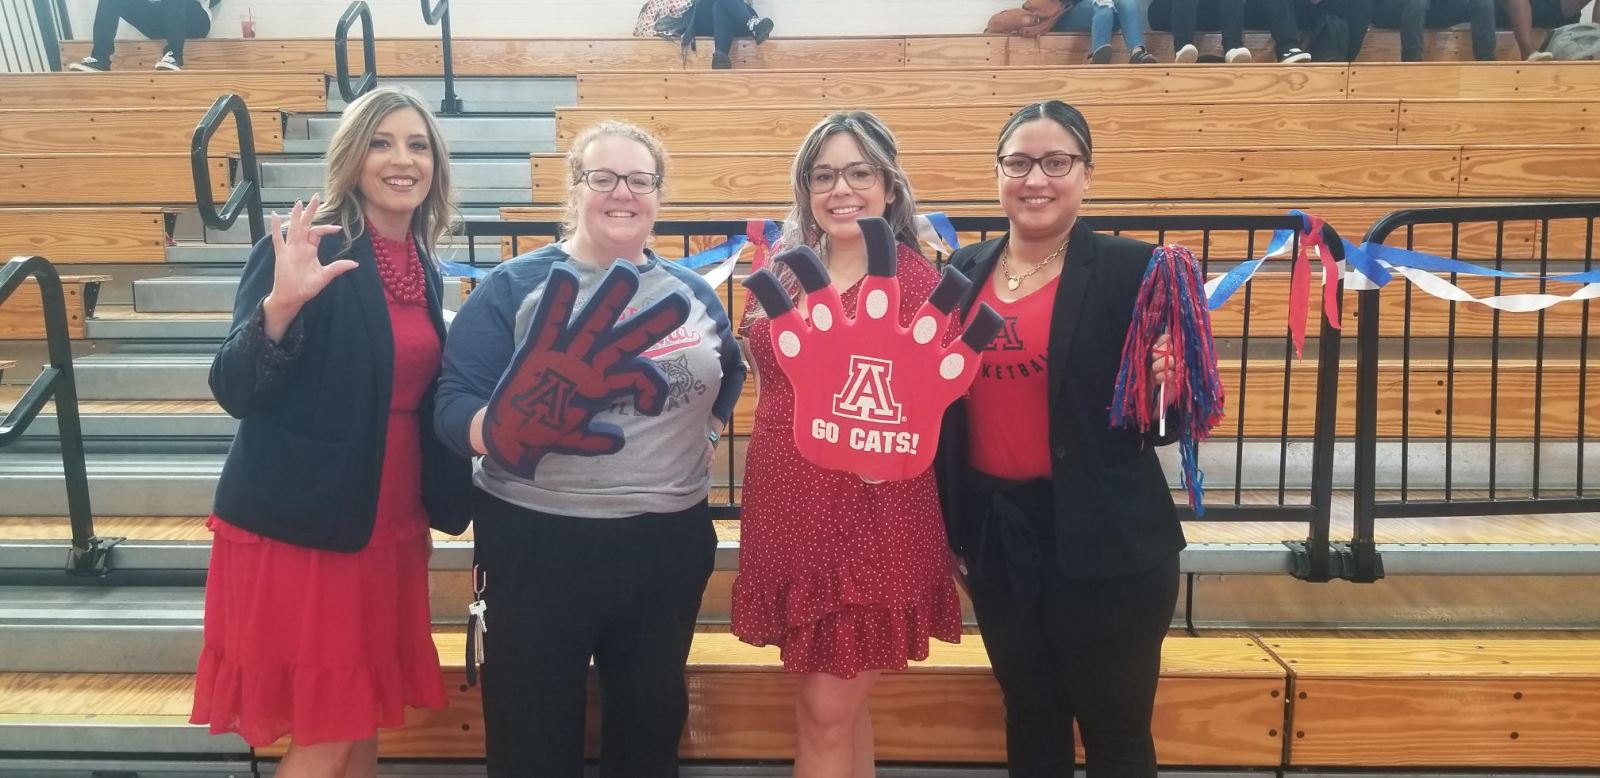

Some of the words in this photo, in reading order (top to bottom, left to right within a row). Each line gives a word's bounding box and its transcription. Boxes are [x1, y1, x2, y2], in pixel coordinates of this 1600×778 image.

[982, 316, 1024, 351] A
[512, 367, 577, 430] A
[831, 354, 902, 424] A
[811, 418, 840, 444] GO
[849, 427, 920, 455] CATS!
